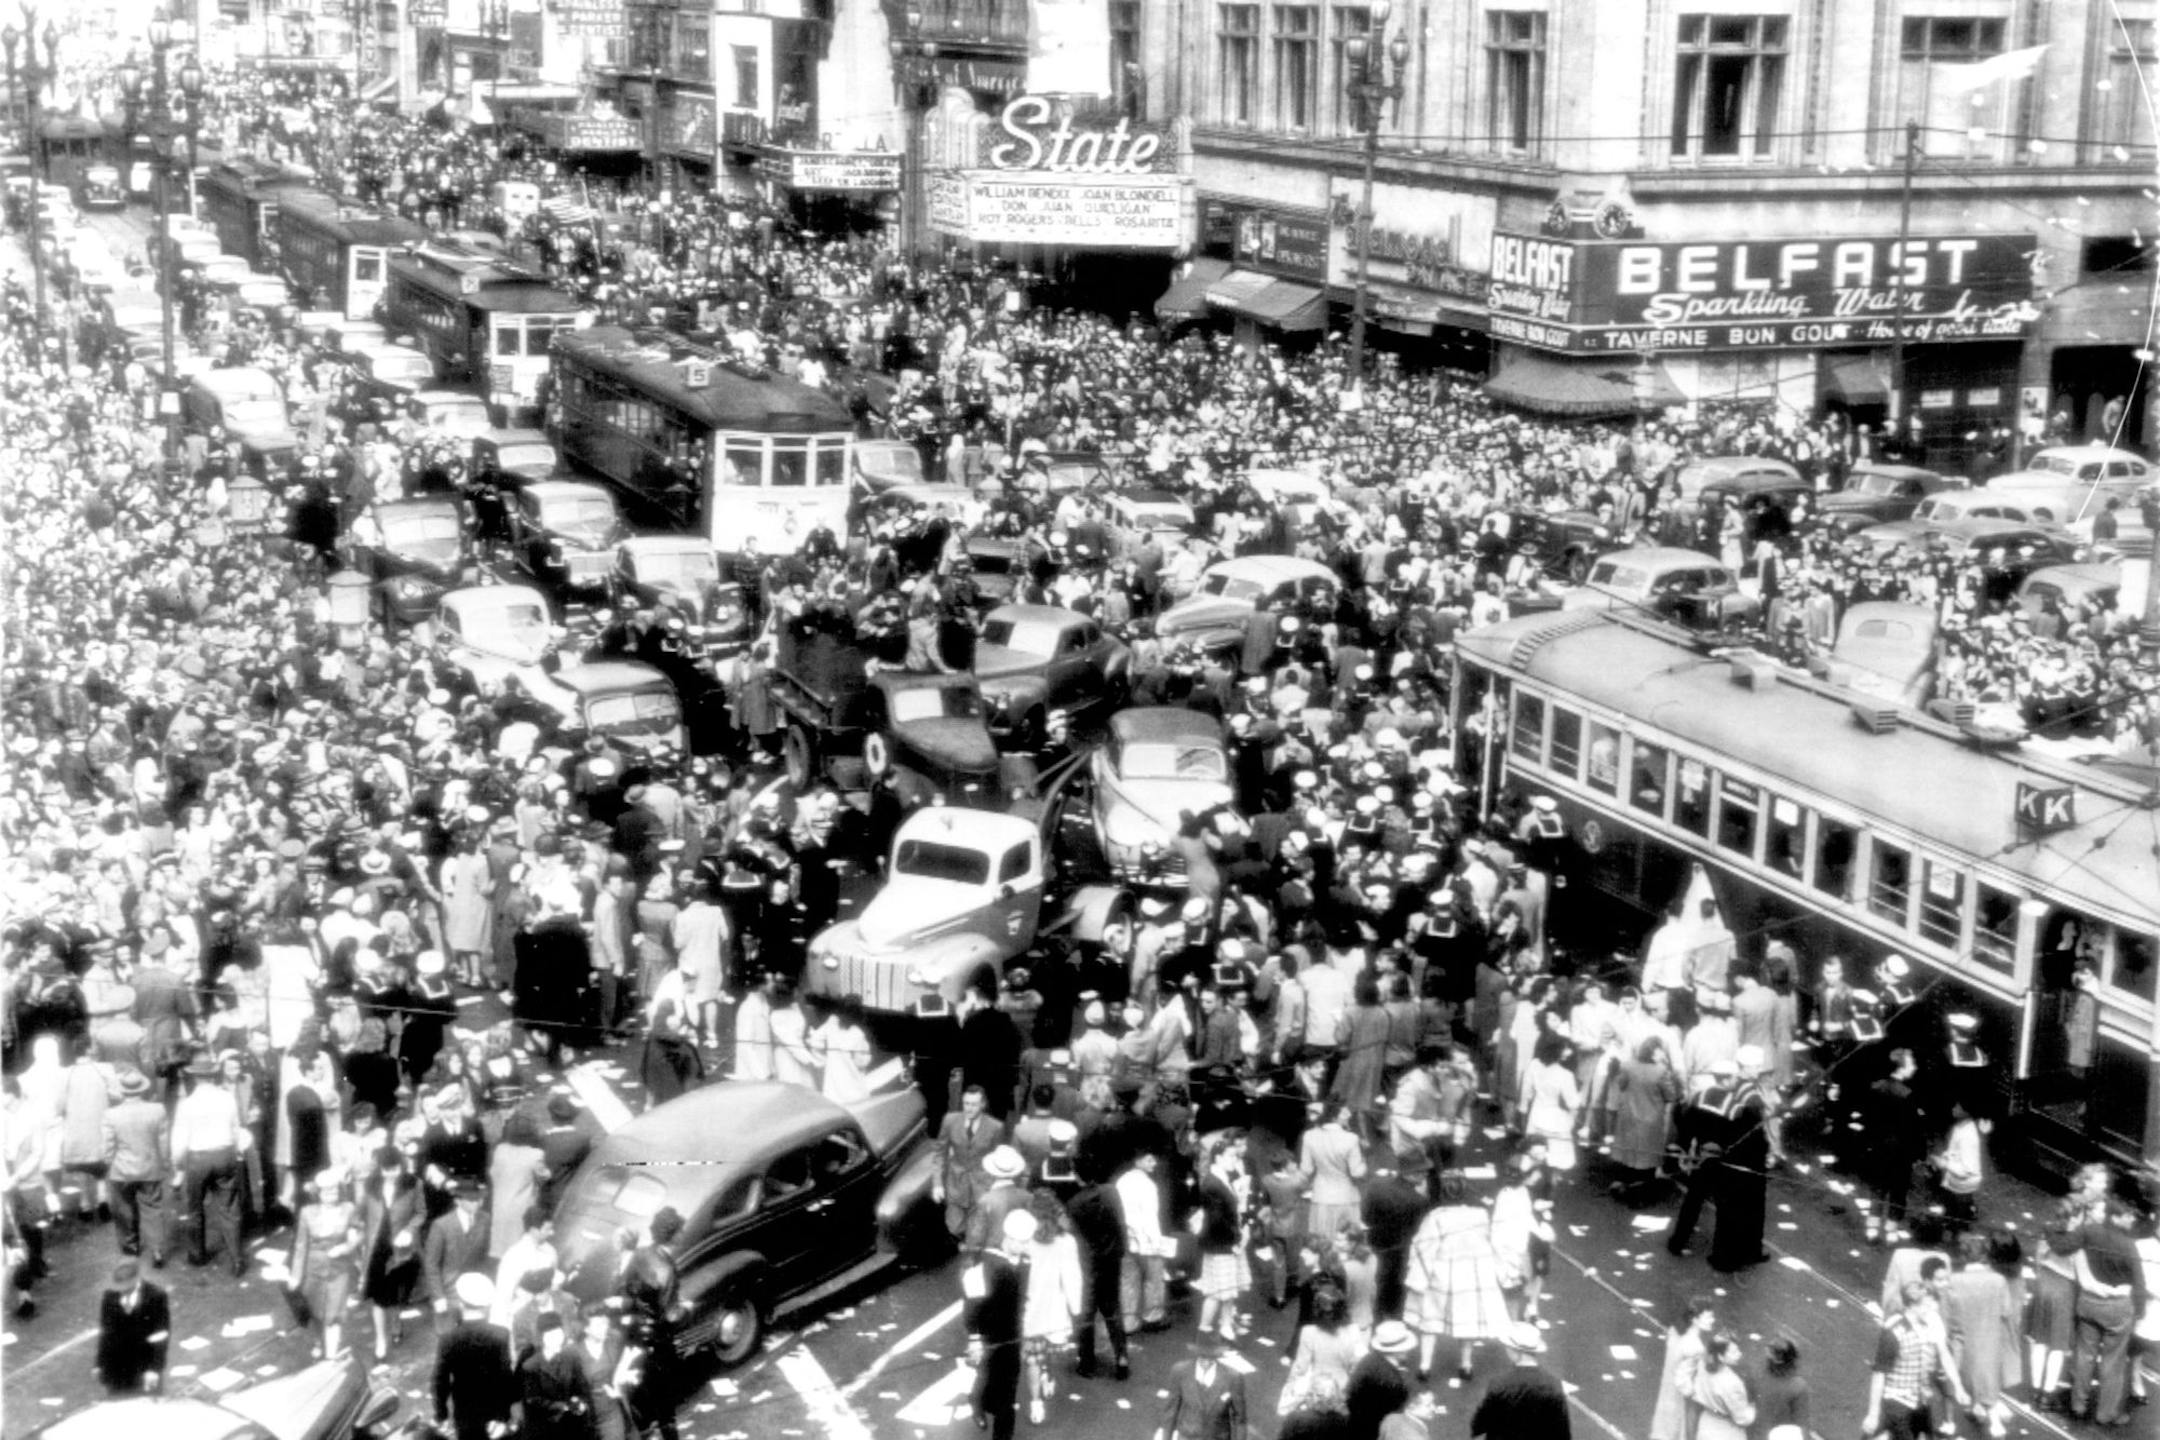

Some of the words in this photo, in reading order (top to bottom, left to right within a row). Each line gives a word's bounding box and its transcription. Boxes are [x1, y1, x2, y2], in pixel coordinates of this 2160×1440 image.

[991, 96, 1159, 173] State
[974, 185, 1025, 198] WILLIAM
[1081, 189, 1111, 200] JOAN
[1115, 189, 1174, 202] BLONDELL
[1002, 200, 1027, 212] DON
[1007, 213, 1053, 225] ROGERS
[1491, 236, 1574, 293] BELFAST
[1617, 240, 1977, 295] BELFAST
[1642, 290, 1812, 327] Sparkling
[1832, 288, 1924, 317] Watr
[1604, 329, 1708, 348] TAVERNE
[1915, 319, 1933, 340] of
[693, 368, 706, 382] 5
[1706, 599, 1720, 618] K
[2019, 785, 2040, 819] K
[2043, 794, 2071, 825] K
